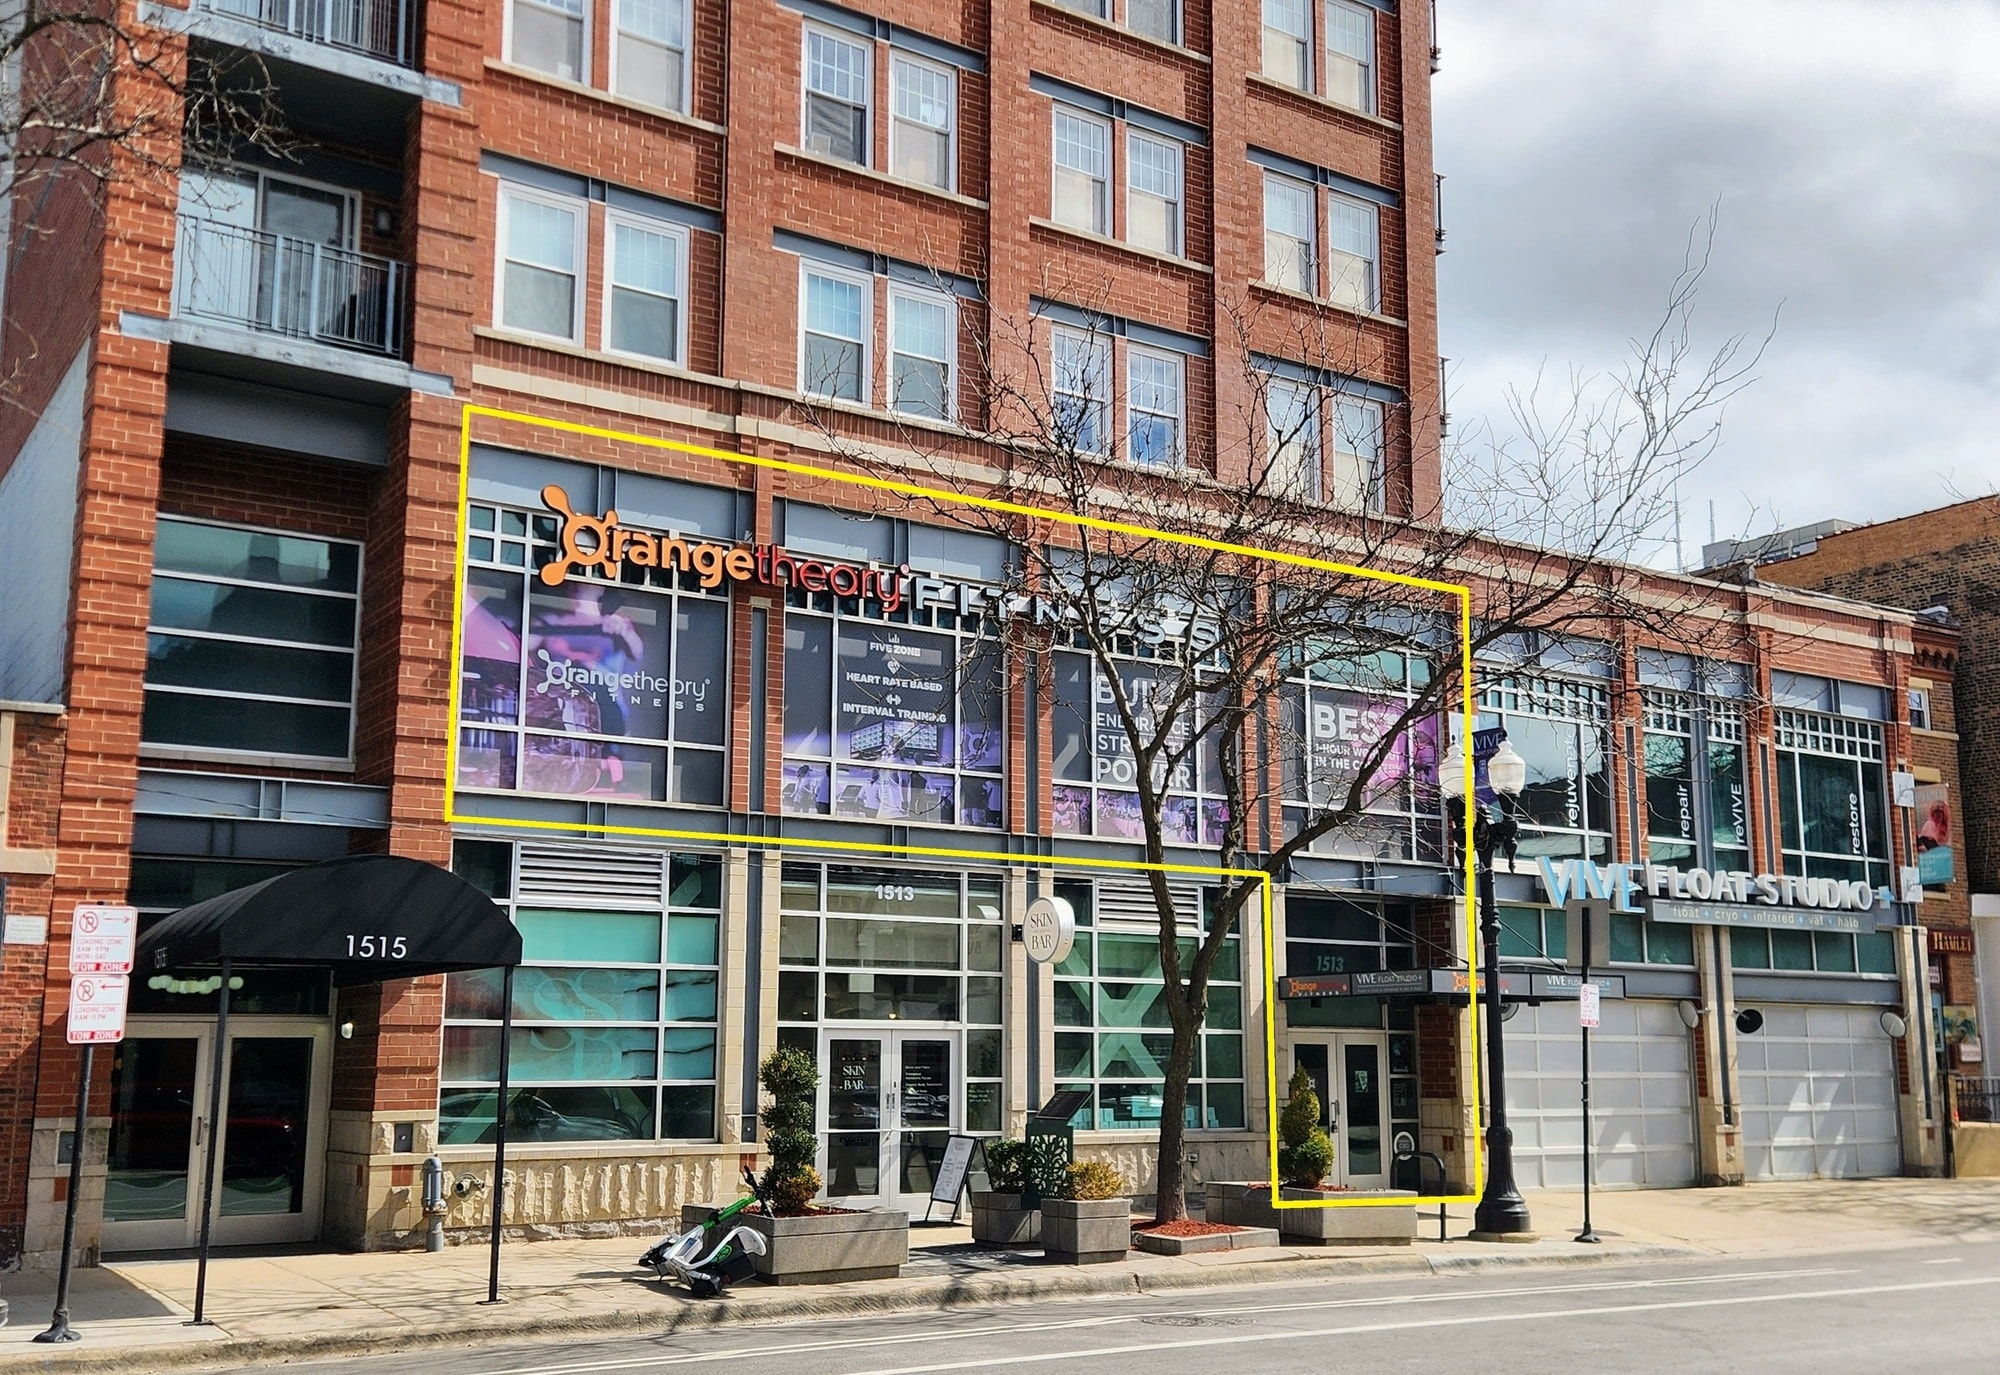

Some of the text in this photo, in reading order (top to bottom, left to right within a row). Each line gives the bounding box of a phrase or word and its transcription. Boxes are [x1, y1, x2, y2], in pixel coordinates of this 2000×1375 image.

[911, 576, 1219, 651] FITNSS
[869, 642, 921, 657] FIVE ZONE
[846, 672, 943, 692] HEART RATE BASED
[842, 702, 947, 723] INTERVAL TRAINING
[1315, 755, 1327, 767] IN
[1329, 757, 1351, 770] THE
[1677, 784, 1692, 838] repair
[1731, 783, 1745, 843] reVIVE
[1849, 792, 1861, 855] restore
[874, 884, 915, 901] 1513
[1535, 857, 1646, 914] VIVE
[1646, 859, 1751, 902] FLOAT
[1756, 873, 1874, 911] STUDIO
[1030, 912, 1053, 928] SKIN
[1673, 906, 1699, 918] float
[1715, 909, 1738, 921] cryo
[1753, 911, 1794, 924] infrared
[1838, 916, 1859, 928] halo
[346, 934, 407, 959] 1515
[1032, 934, 1052, 950] BAR
[75, 963, 124, 972] TOW ZONE
[1316, 955, 1344, 972] 1513
[1356, 973, 1376, 984] VIVE
[1378, 975, 1395, 983] FLOAT
[1547, 975, 1566, 986] VIVE
[71, 1031, 118, 1040] TOW ZONE
[842, 1065, 866, 1076] SKIN
[844, 1079, 864, 1090] BAR
